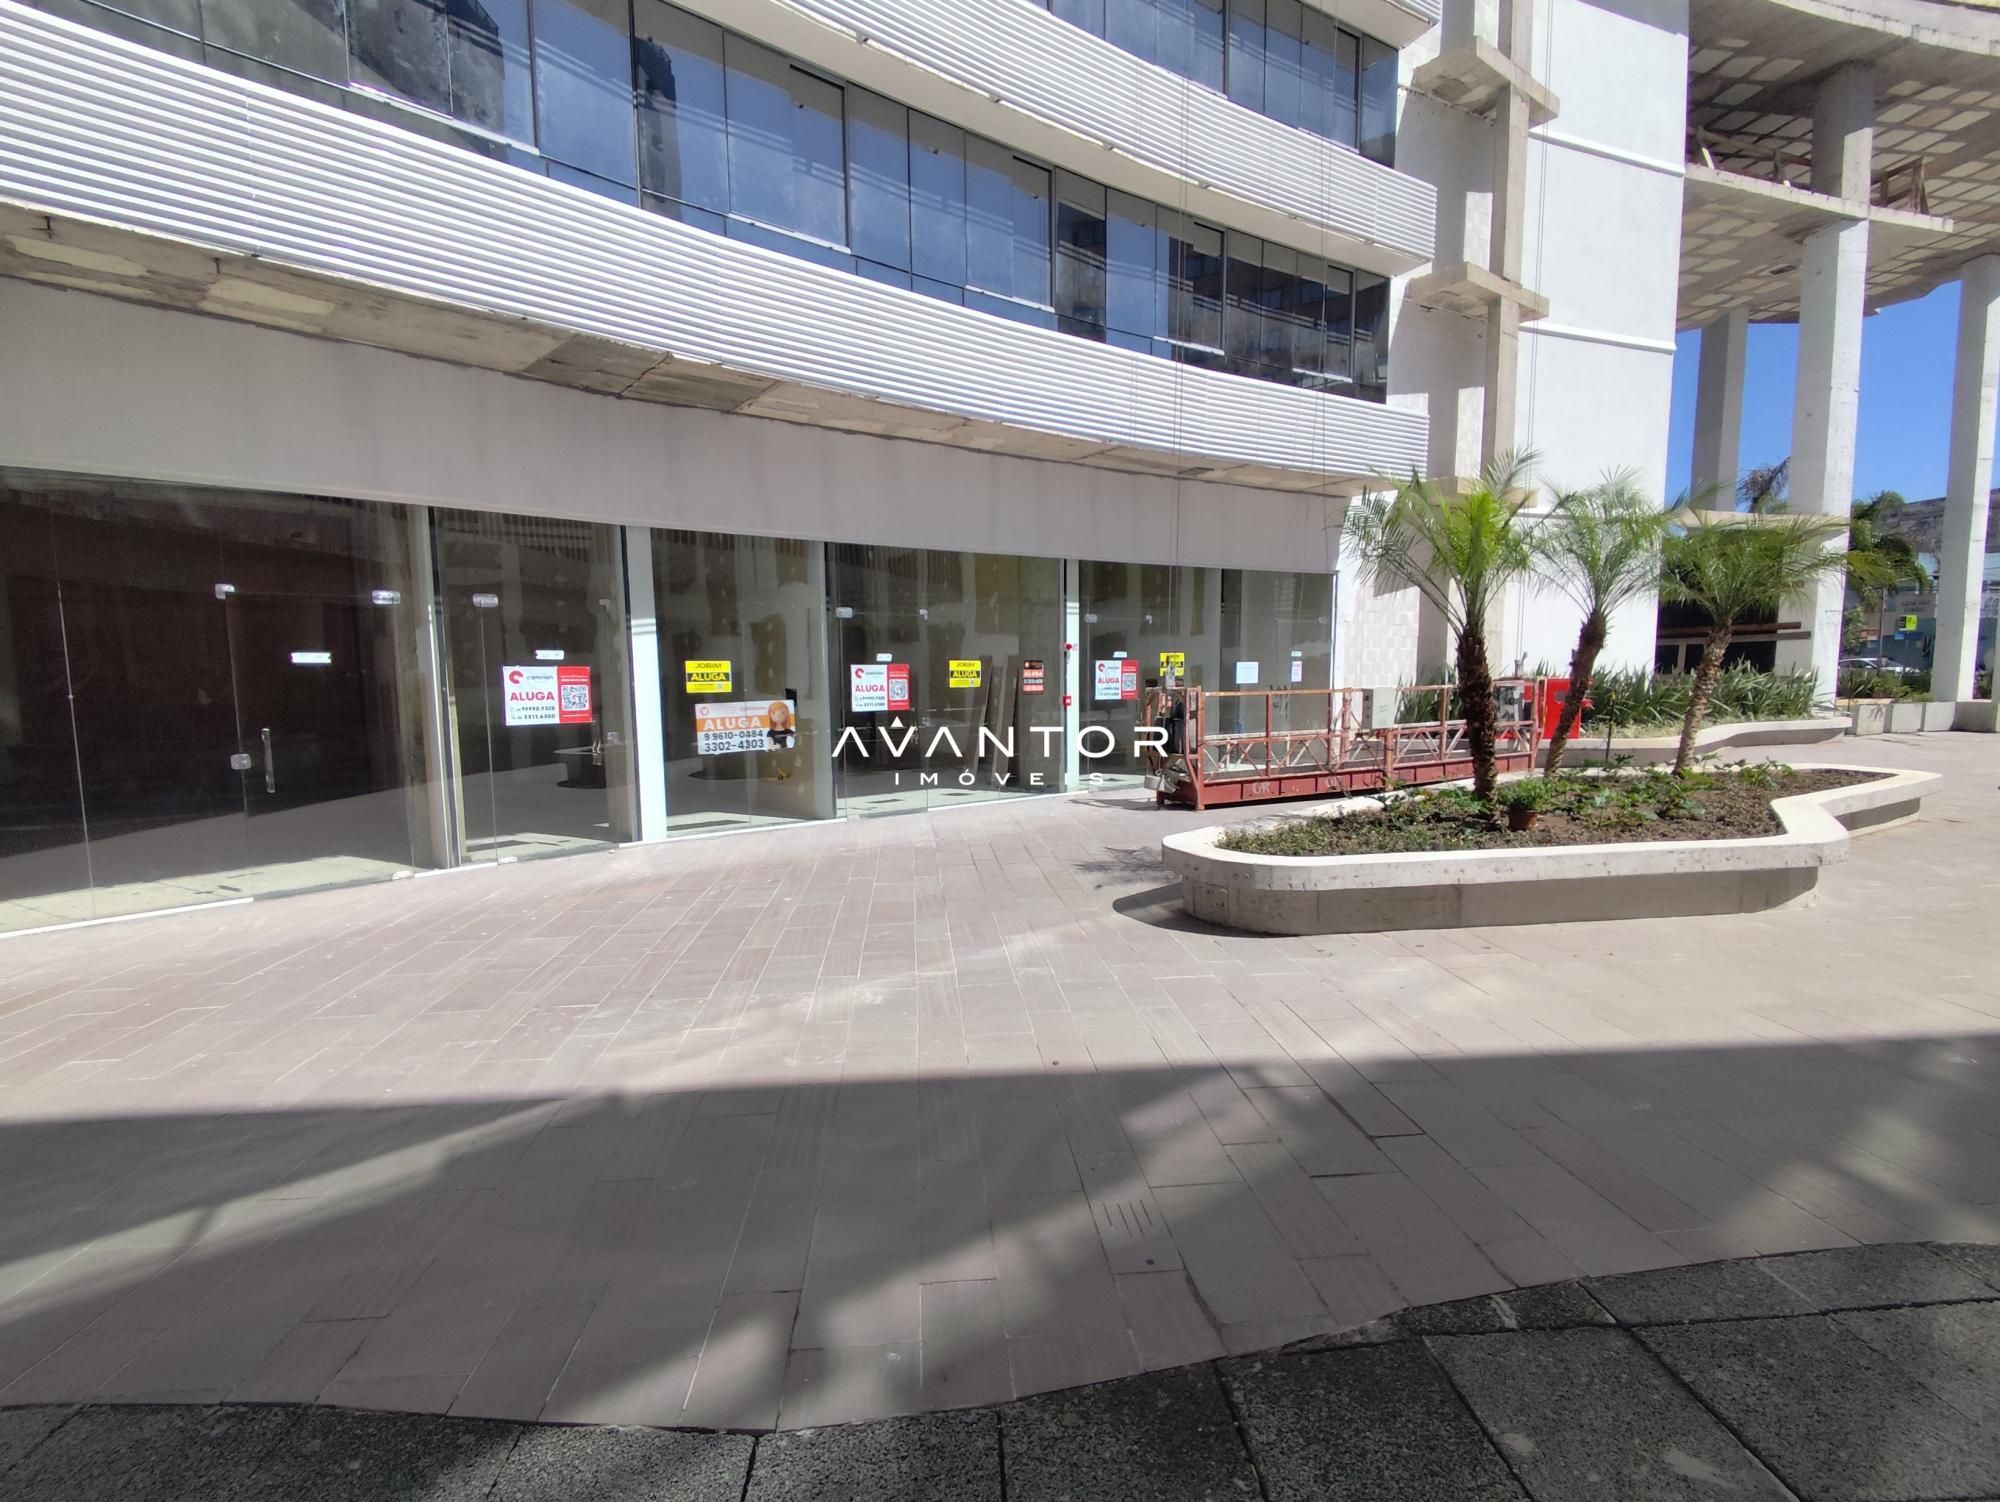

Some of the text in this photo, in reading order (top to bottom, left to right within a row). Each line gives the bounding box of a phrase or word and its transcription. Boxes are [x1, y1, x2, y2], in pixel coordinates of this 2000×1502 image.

[690, 672, 727, 681] ALUGA
[952, 670, 978, 678] ALUGA
[1097, 677, 1120, 685] ALUGA
[854, 684, 886, 693] ALUGA
[510, 691, 555, 702] ALUGA
[703, 716, 763, 732] ALUGA
[703, 732, 710, 742] 9
